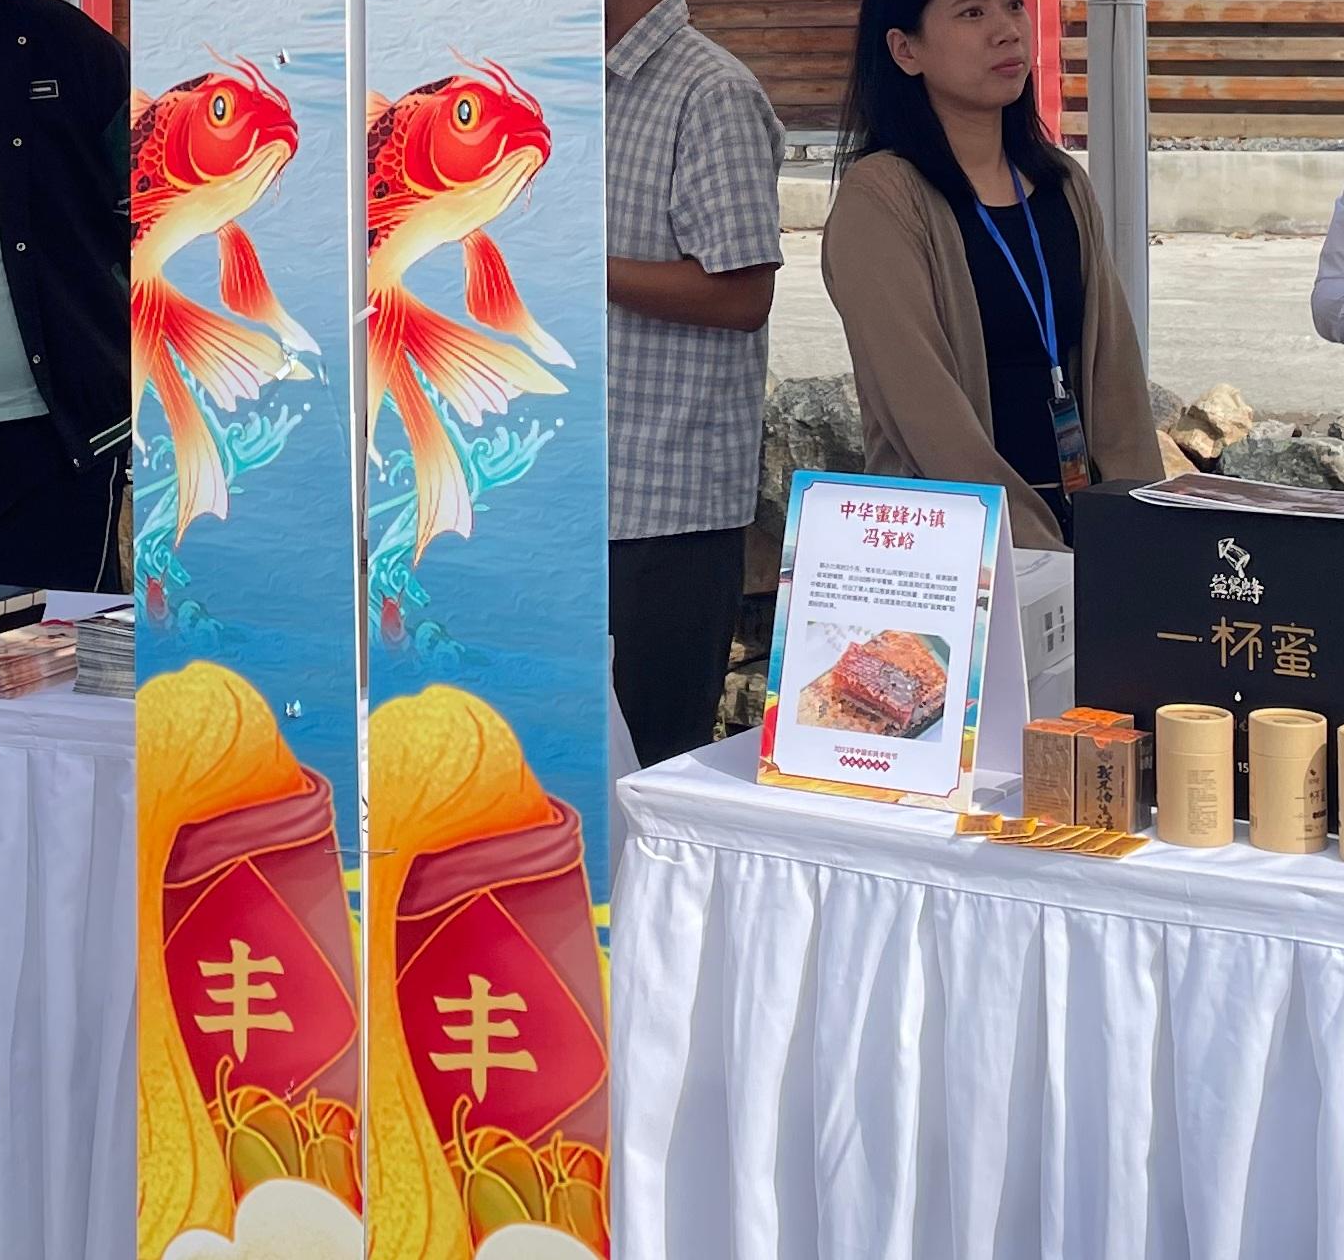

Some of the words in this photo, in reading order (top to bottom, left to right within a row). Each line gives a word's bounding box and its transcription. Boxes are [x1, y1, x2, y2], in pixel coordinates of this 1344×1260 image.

[841, 501, 946, 528] 中华蜜蜂小镇
[863, 528, 915, 550] 冯家峪
[1157, 616, 1318, 678] 一杯蜜
[194, 939, 294, 1063] 丰
[428, 974, 538, 1103] 丰
